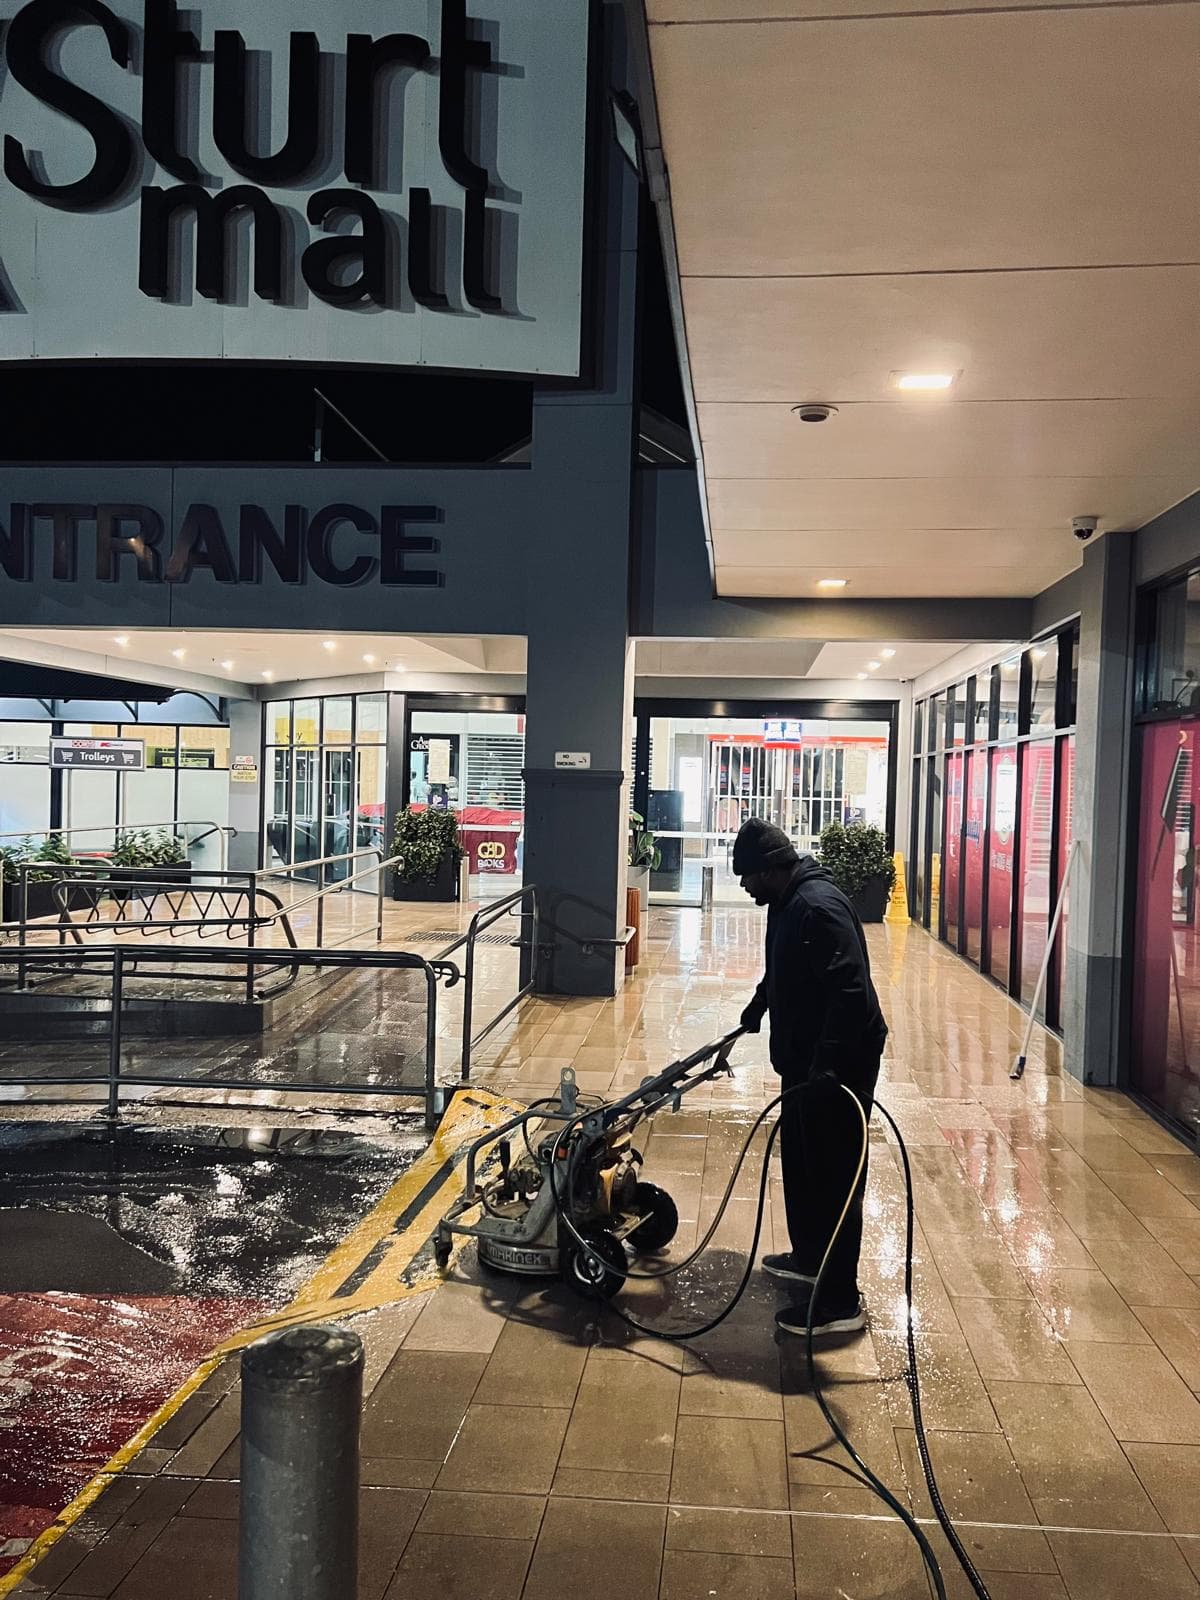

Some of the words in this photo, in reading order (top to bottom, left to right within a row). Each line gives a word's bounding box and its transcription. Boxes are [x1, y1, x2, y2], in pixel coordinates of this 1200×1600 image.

[4, 0, 494, 204] Sturt
[139, 184, 504, 312] mall
[79, 751, 115, 764] Trolleys
[478, 841, 505, 859] QBD
[478, 859, 505, 868] BOOKS
